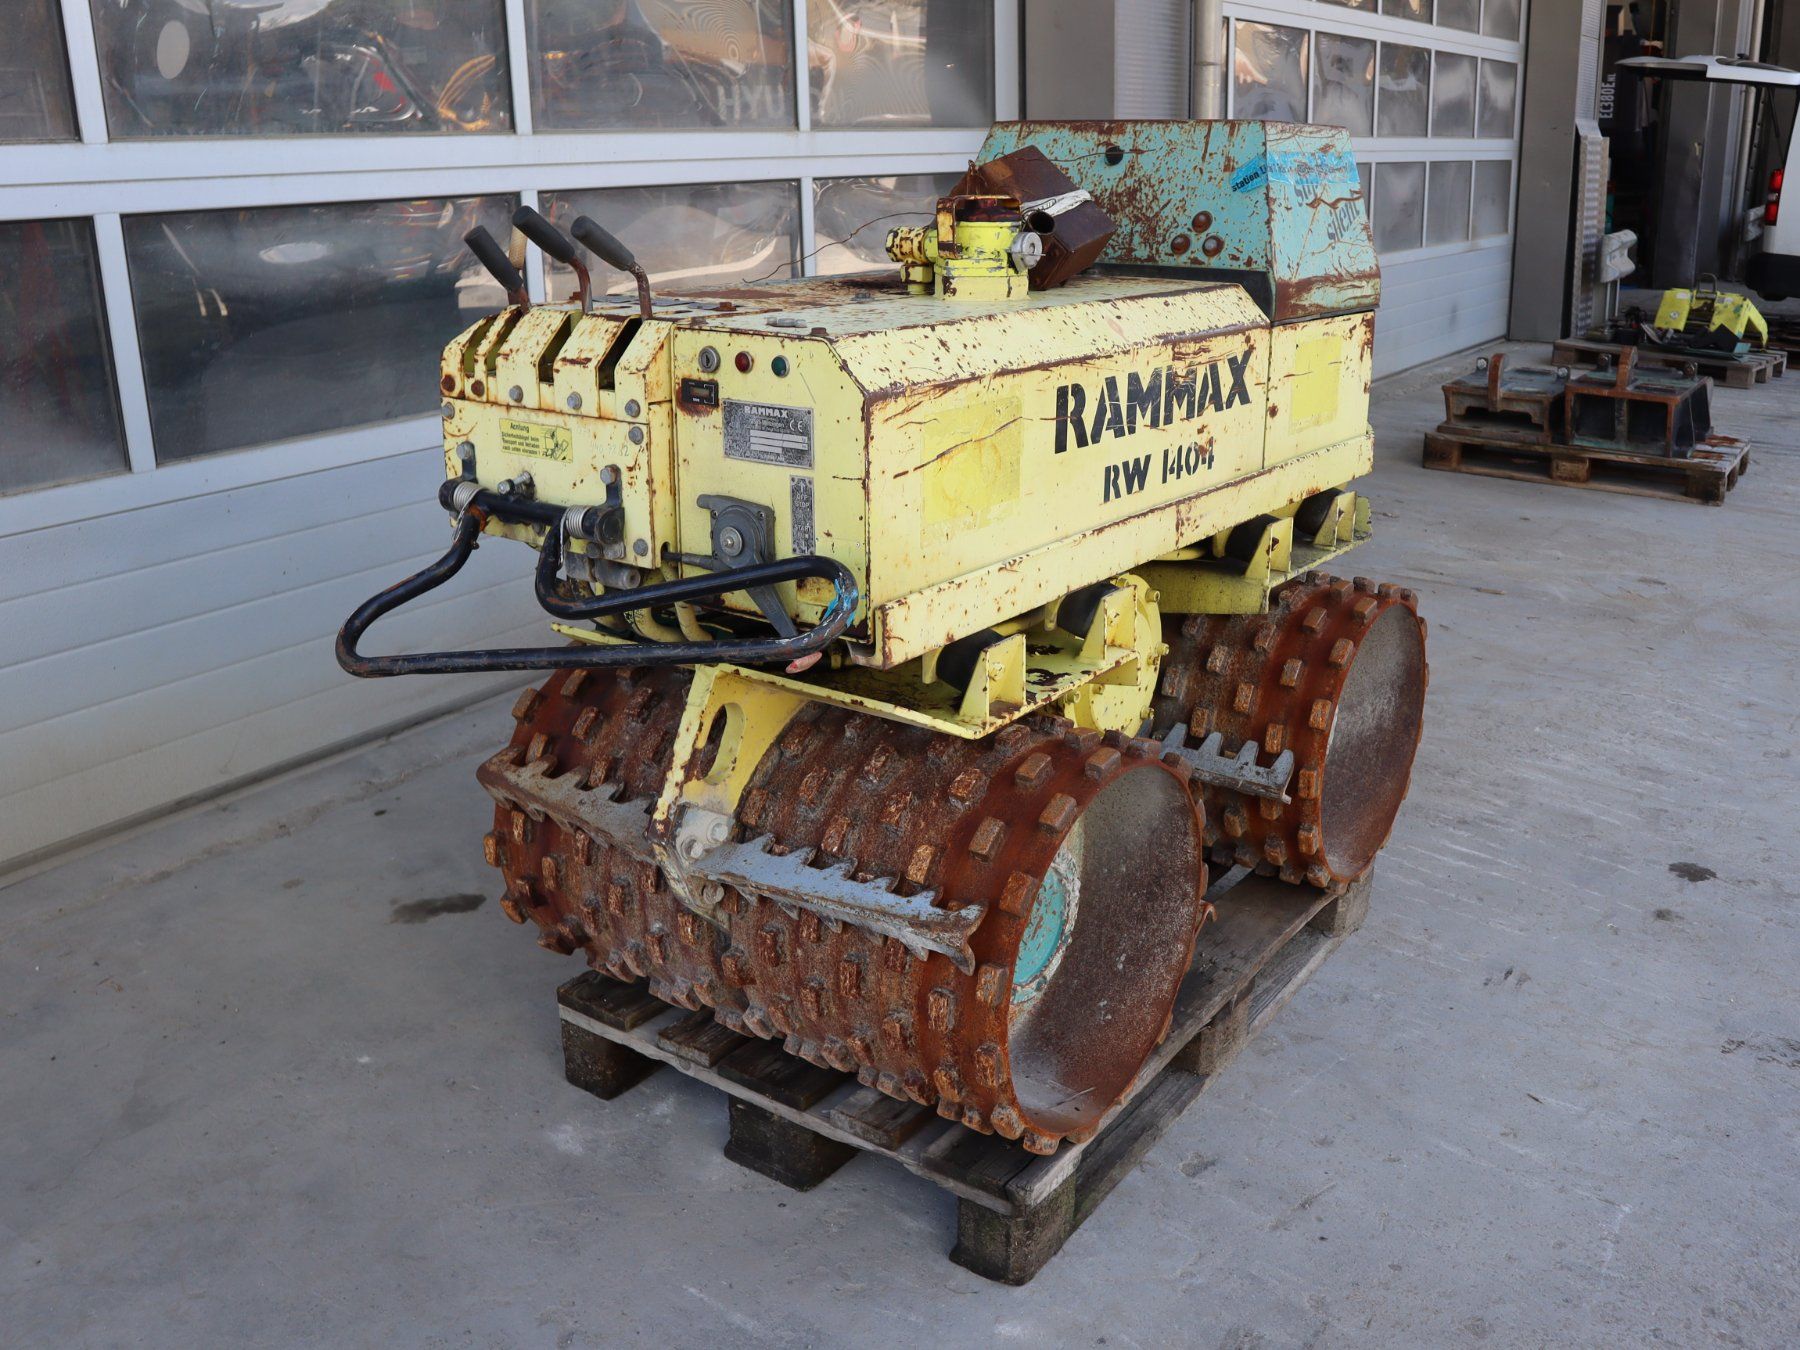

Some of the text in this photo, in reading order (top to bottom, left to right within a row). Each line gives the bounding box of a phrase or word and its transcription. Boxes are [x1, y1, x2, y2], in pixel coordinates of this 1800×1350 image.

[1231, 170, 1260, 192] station
[744, 405, 789, 419] RAMMAX
[1054, 349, 1252, 454] RAMMAX
[1104, 436, 1215, 503] RW 1404
